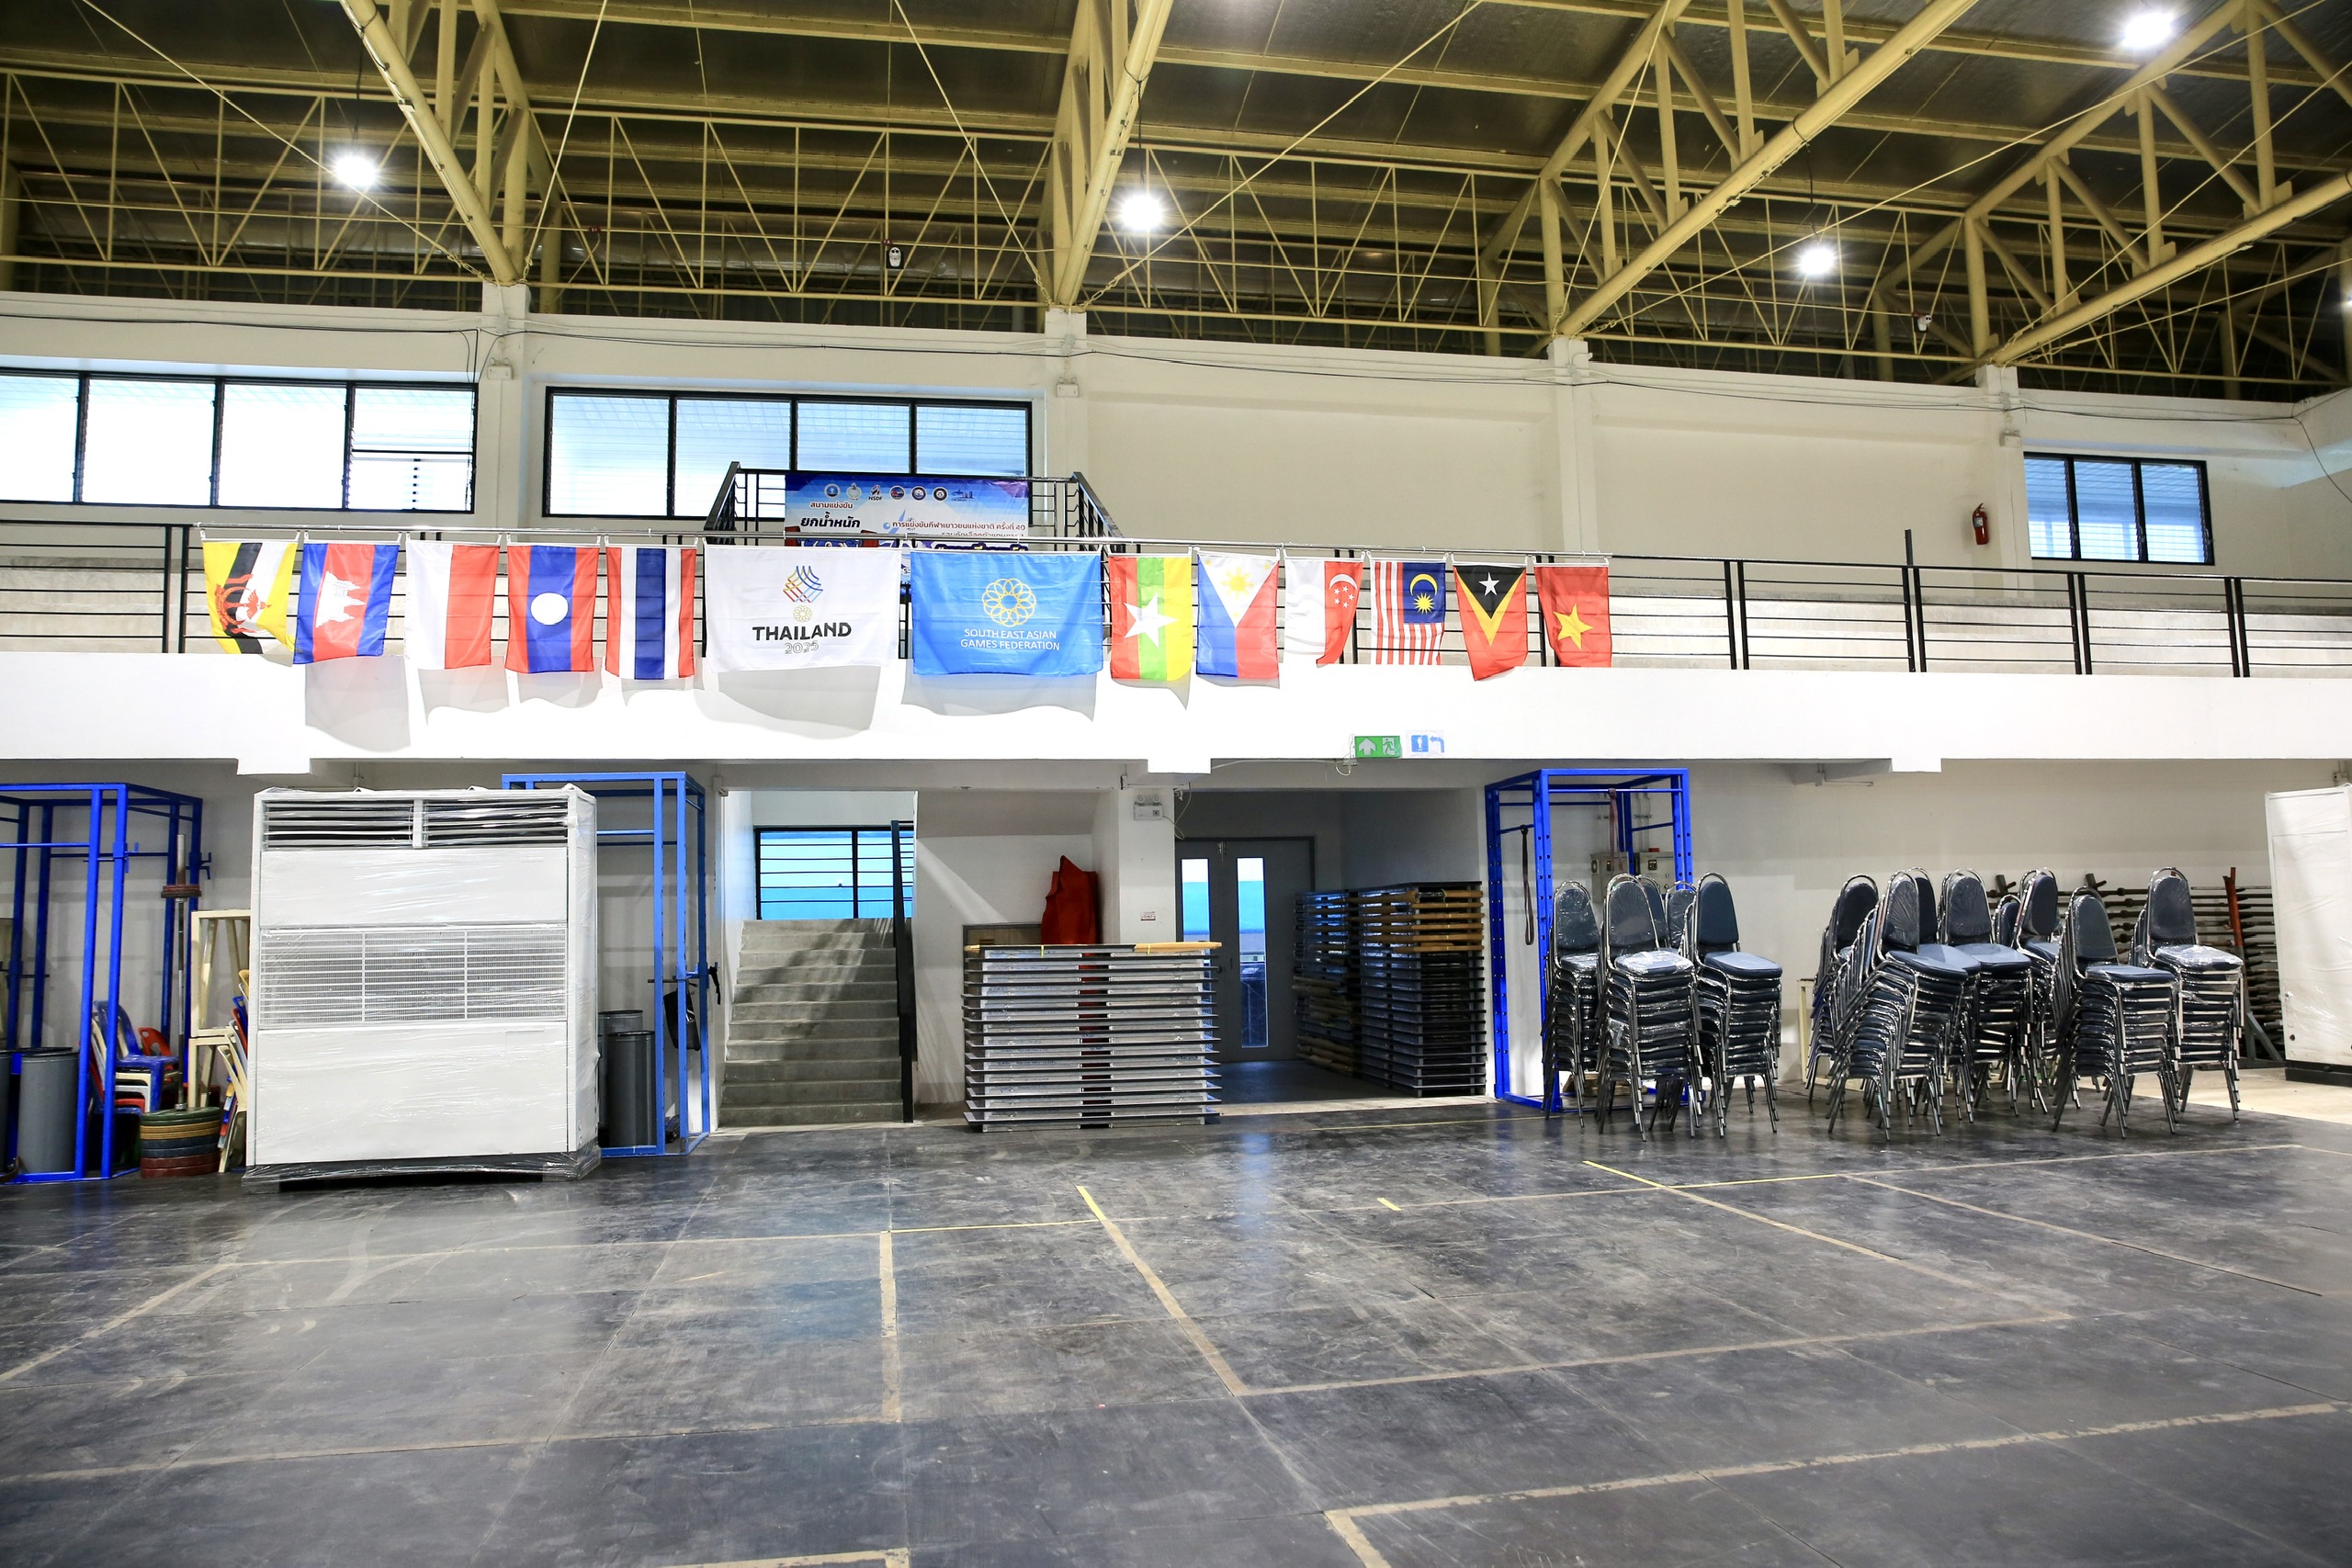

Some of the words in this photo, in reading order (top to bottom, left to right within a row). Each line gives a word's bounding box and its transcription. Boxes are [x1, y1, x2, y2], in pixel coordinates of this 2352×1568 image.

[800, 512, 861, 528] ยกน้ำหนัก
[752, 622, 853, 641] THAILAND
[964, 628, 1000, 637] SOUTH
[1002, 630, 1024, 638] EAST
[1026, 630, 1057, 639] ASIAN
[784, 640, 820, 655] 2025
[960, 638, 998, 649] GAMES
[999, 640, 1060, 650] FEDERATION
